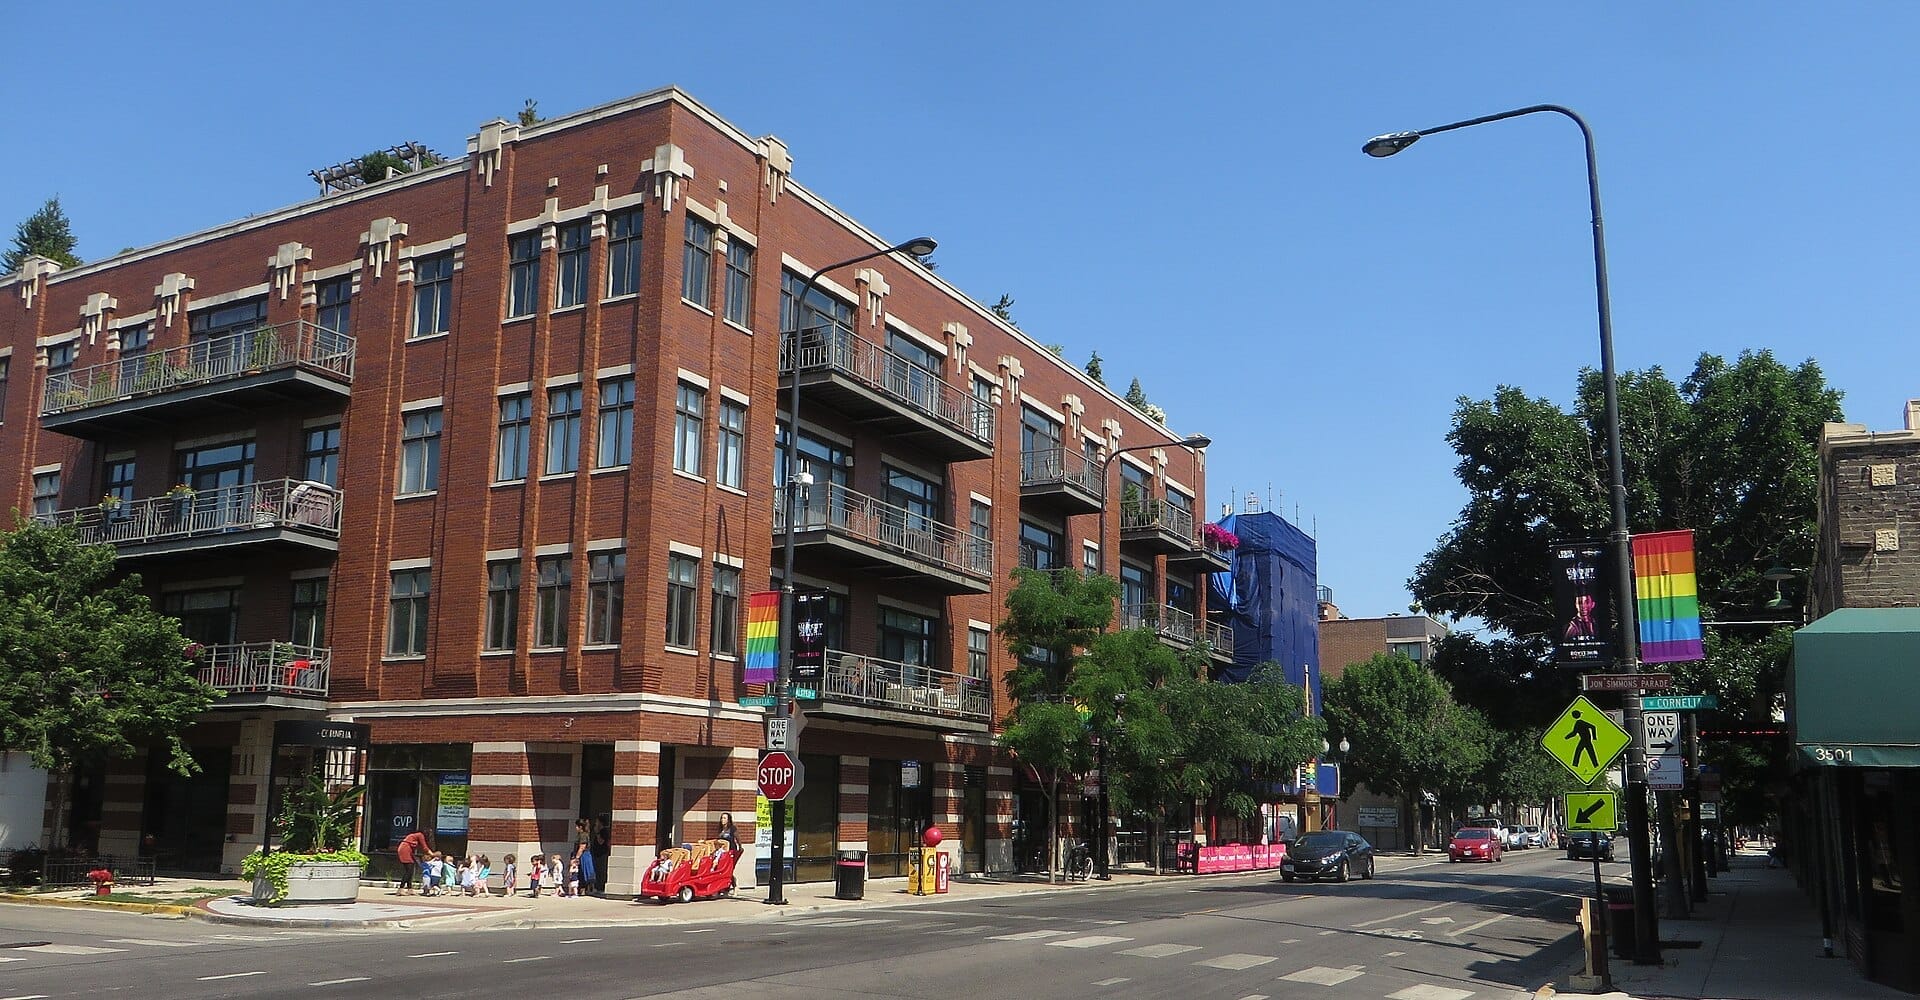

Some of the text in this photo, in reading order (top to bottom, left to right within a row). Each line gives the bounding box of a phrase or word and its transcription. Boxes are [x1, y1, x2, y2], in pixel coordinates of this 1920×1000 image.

[1607, 680, 1638, 688] SIMMONS
[1641, 680, 1669, 688] PARADE
[770, 721, 786, 729] ONE
[1648, 716, 1675, 726] ONE
[1648, 728, 1676, 738] WAY
[1815, 748, 1853, 762] 3501
[760, 767, 792, 785] STOP
[393, 815, 413, 827] GVP
